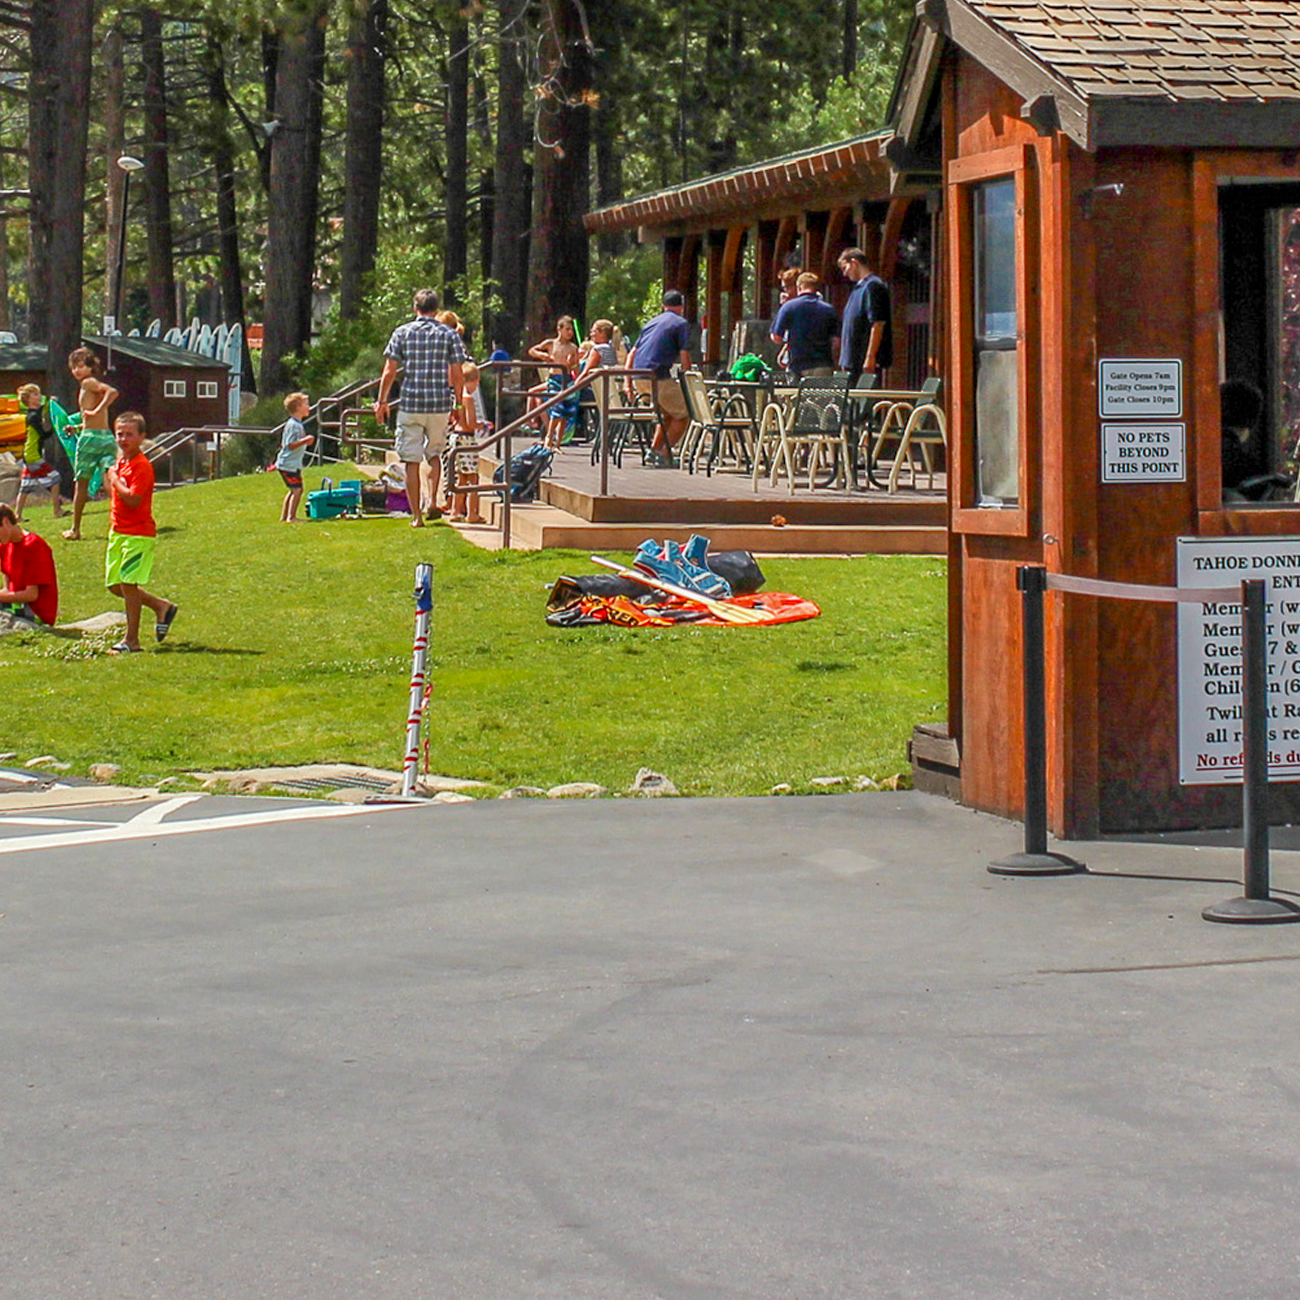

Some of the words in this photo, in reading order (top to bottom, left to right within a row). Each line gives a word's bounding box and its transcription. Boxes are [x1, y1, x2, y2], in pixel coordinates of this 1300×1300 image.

[1110, 372, 1127, 380] Gate
[1129, 372, 1152, 381] Opens
[1155, 372, 1171, 380] 7am
[1105, 383, 1132, 392] Facility
[1134, 383, 1157, 391] Closes
[1159, 383, 1176, 392] 9pm
[1127, 395, 1150, 403] Closes
[1153, 395, 1174, 405] 10pm
[1117, 432, 1135, 443] NO
[1138, 432, 1170, 443] PETS
[1118, 447, 1170, 458] BEYOND
[1108, 462, 1138, 473] THIS
[1142, 462, 1179, 473] POINT
[1193, 556, 1248, 570] TAHOE
[1202, 602, 1274, 616] Memr
[1203, 623, 1274, 637] Memr
[1285, 640, 1298, 654] &
[1204, 662, 1275, 676] Memr
[1280, 660, 1286, 676] /
[1204, 680, 1280, 695] Chiln
[1285, 678, 1300, 696] (6
[1206, 705, 1278, 720] Twilt
[1206, 729, 1228, 743] all
[1196, 754, 1217, 766] No
